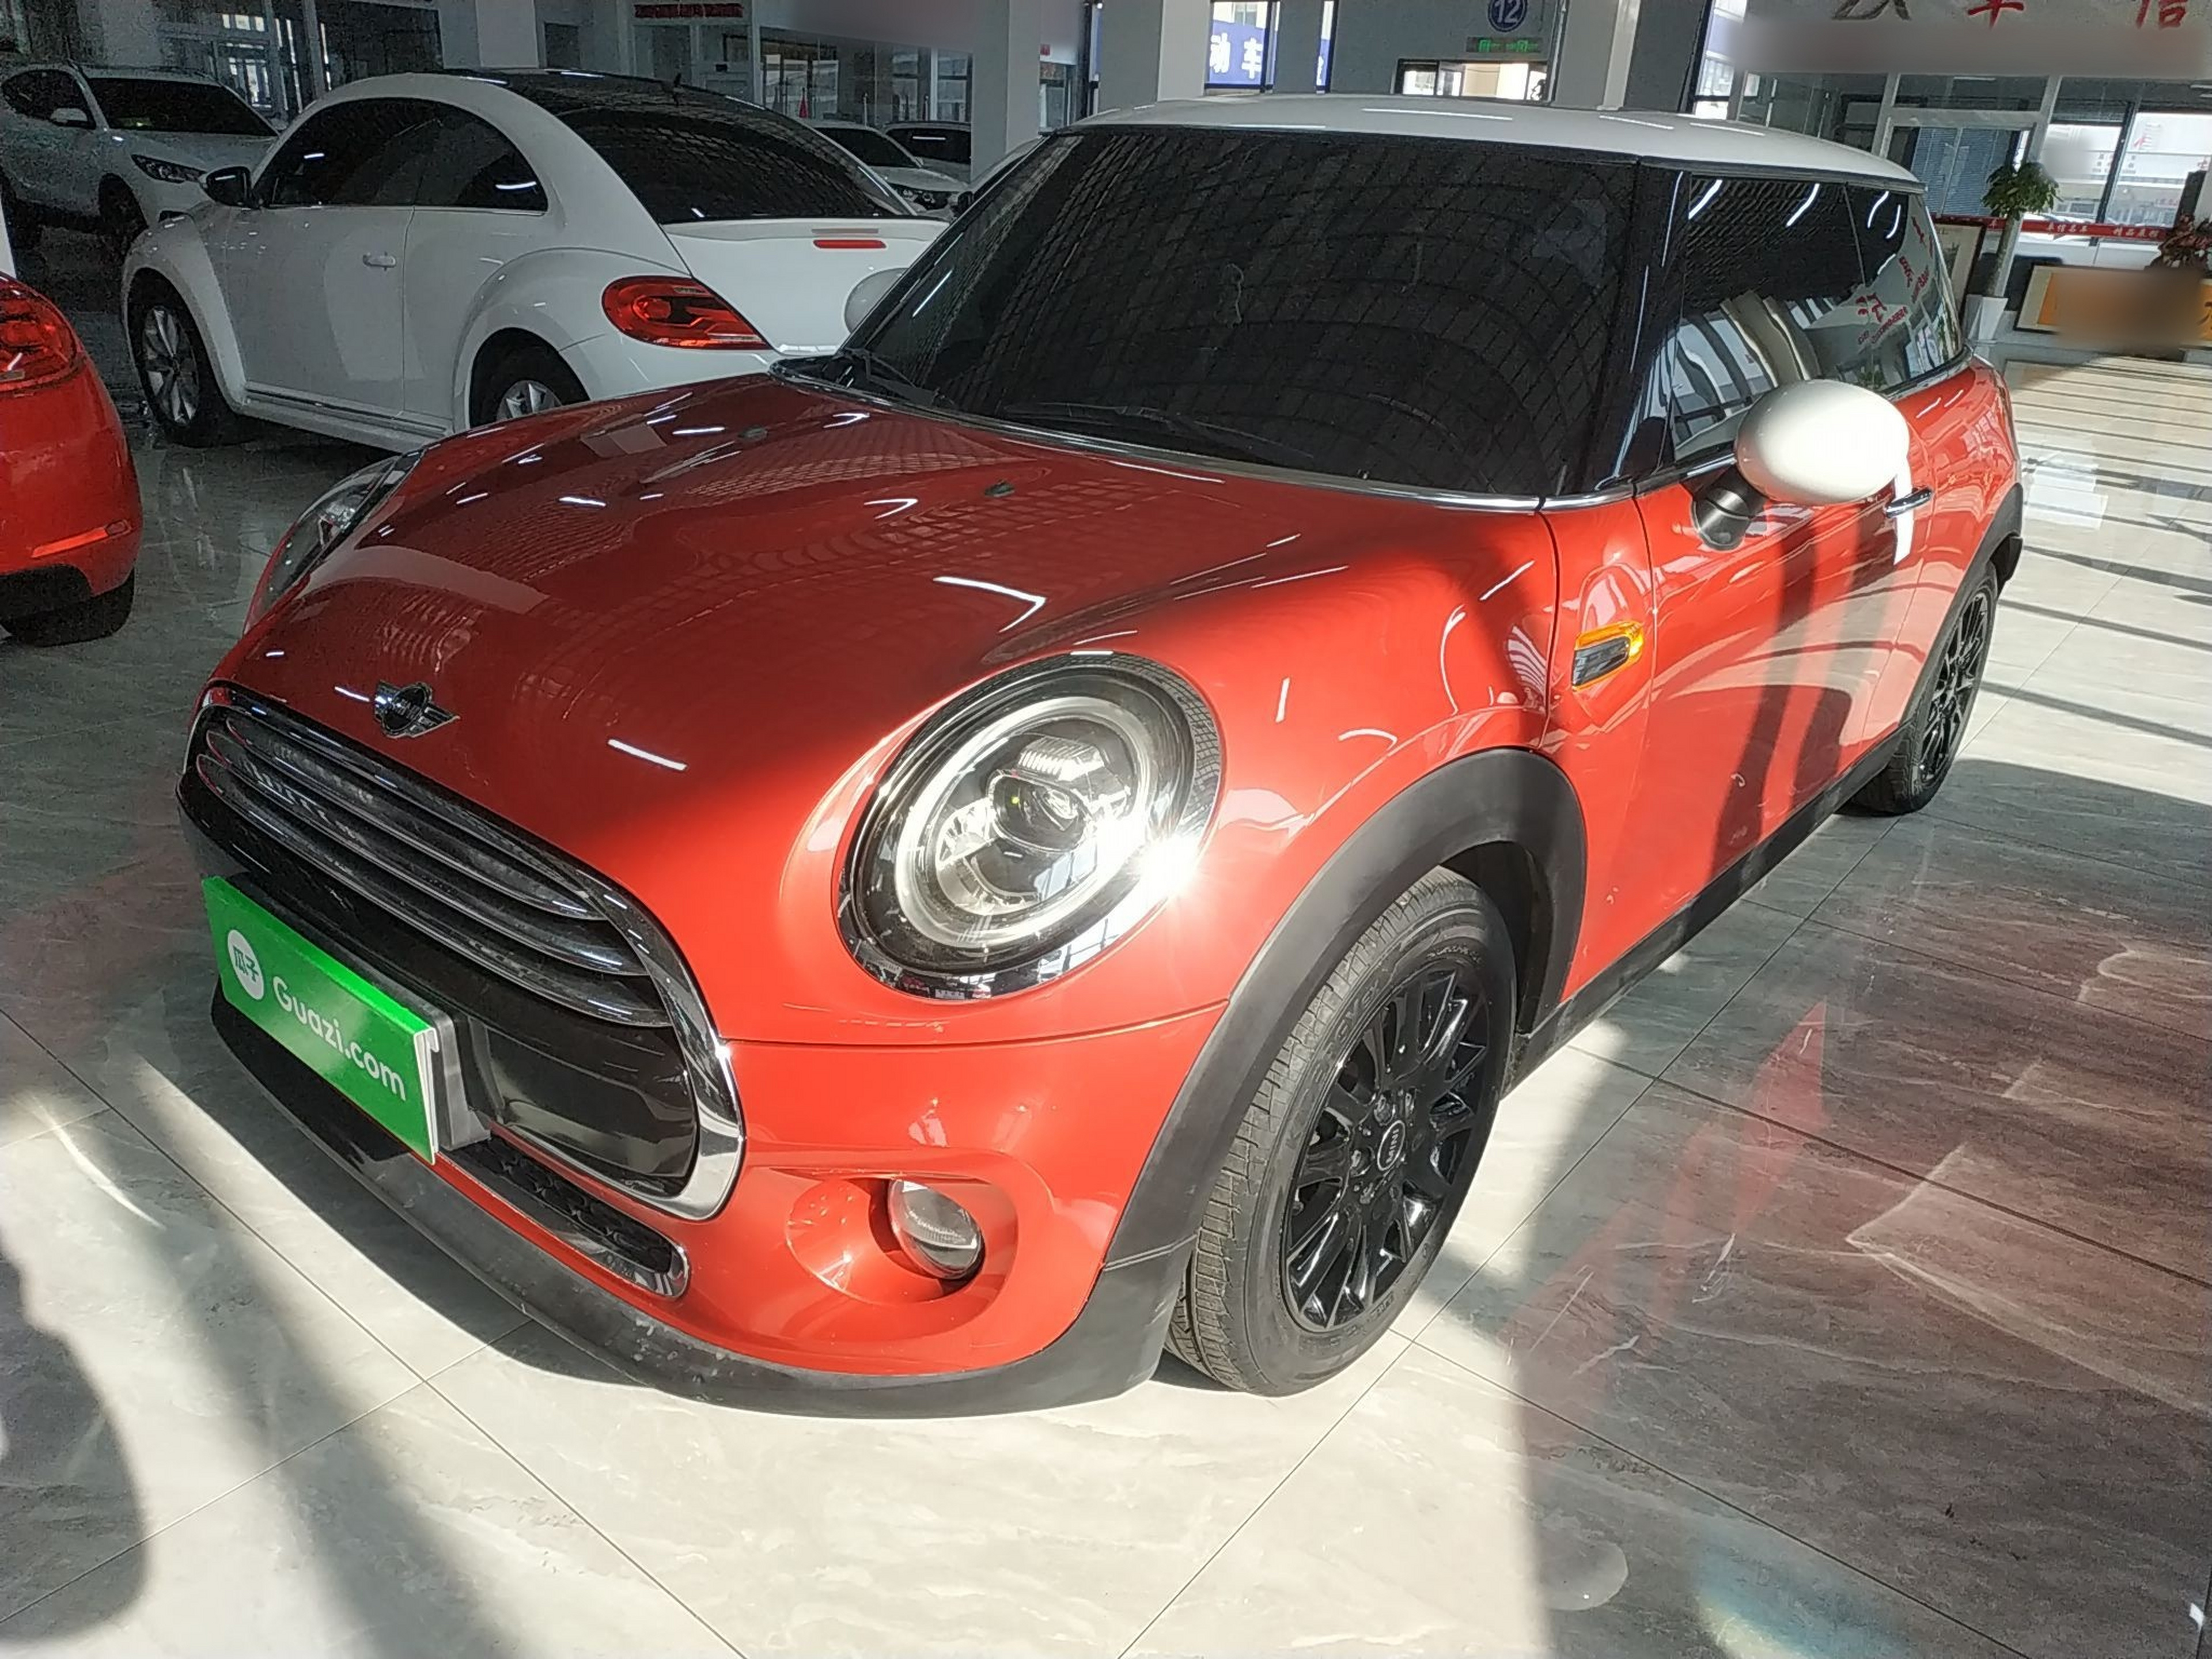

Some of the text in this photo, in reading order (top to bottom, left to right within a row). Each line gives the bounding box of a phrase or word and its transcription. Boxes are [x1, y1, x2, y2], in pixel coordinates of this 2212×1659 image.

[1495, 0, 1521, 23] 12
[233, 945, 259, 983] 瓜子
[272, 976, 406, 1101] Guazi.com
[1385, 1128, 1400, 1164] MINI
